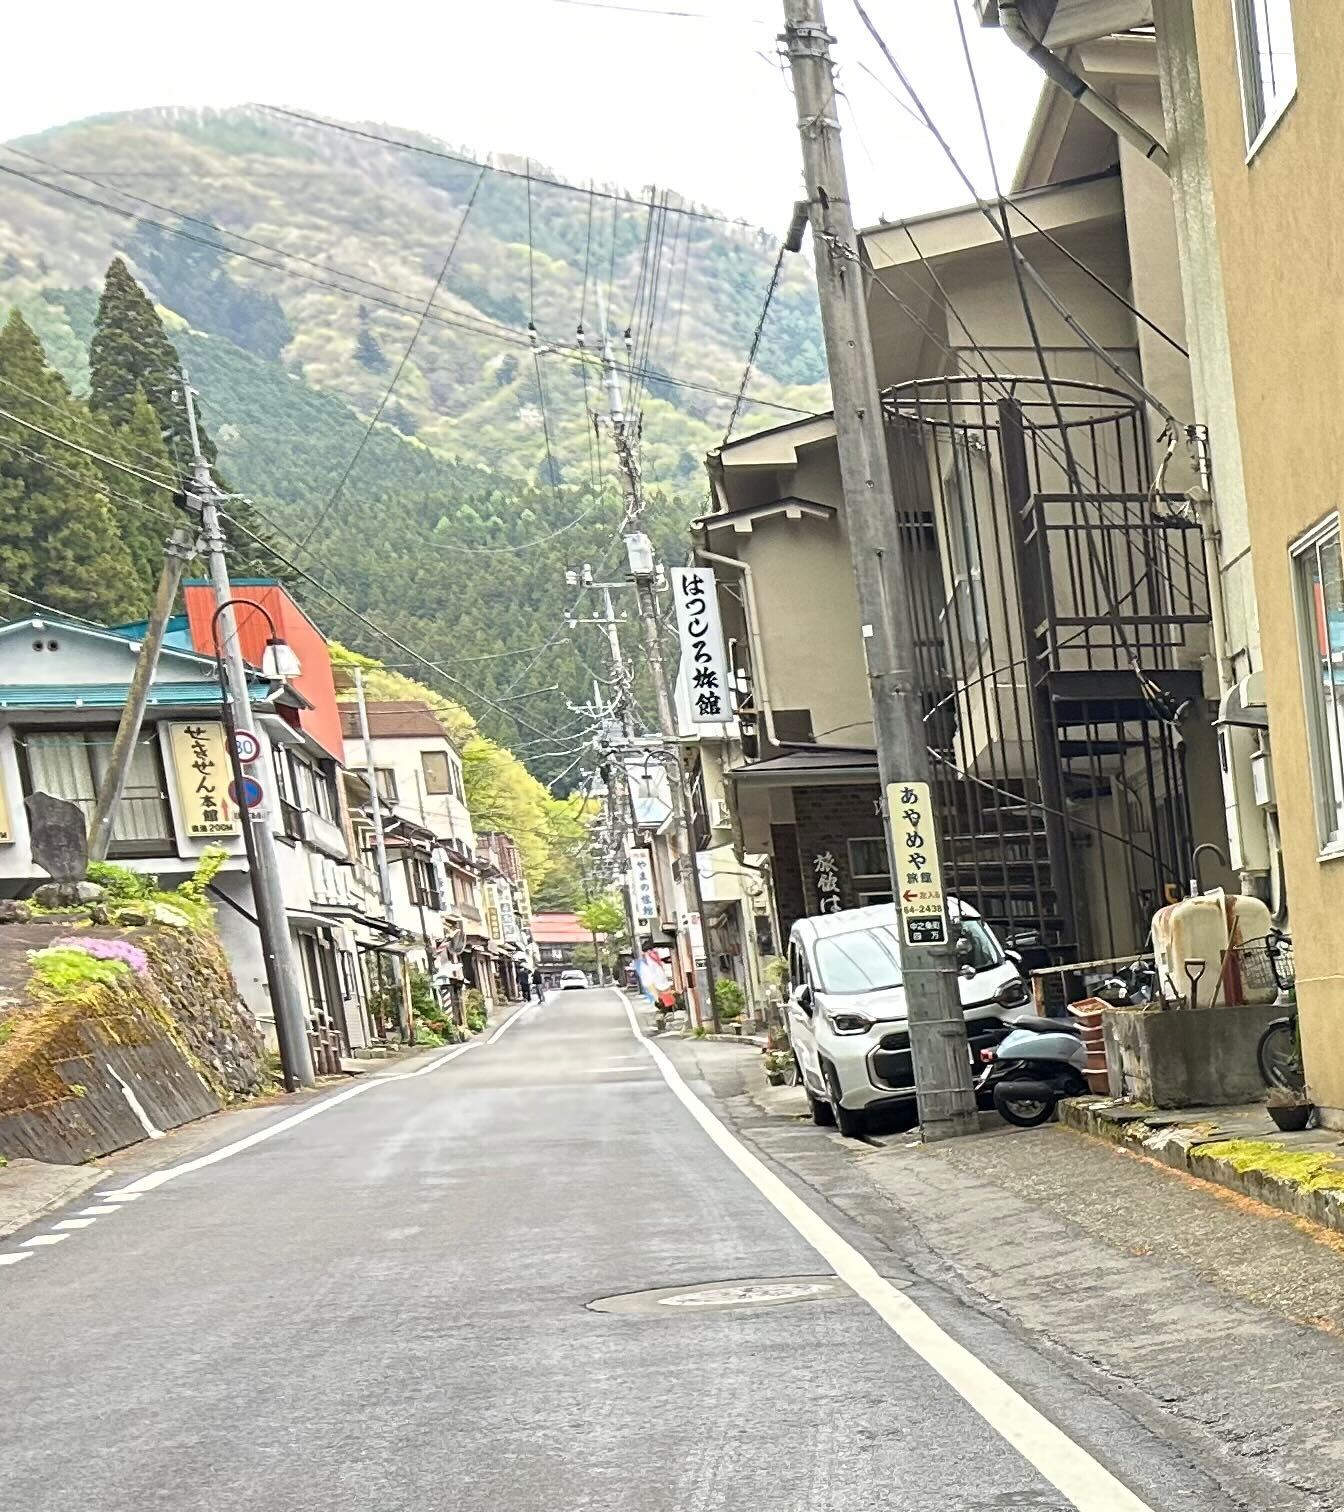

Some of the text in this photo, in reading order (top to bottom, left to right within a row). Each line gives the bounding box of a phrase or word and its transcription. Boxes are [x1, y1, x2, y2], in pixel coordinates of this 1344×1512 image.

[682, 573, 721, 716] はつしろ旅館
[900, 786, 926, 871] あやめや
